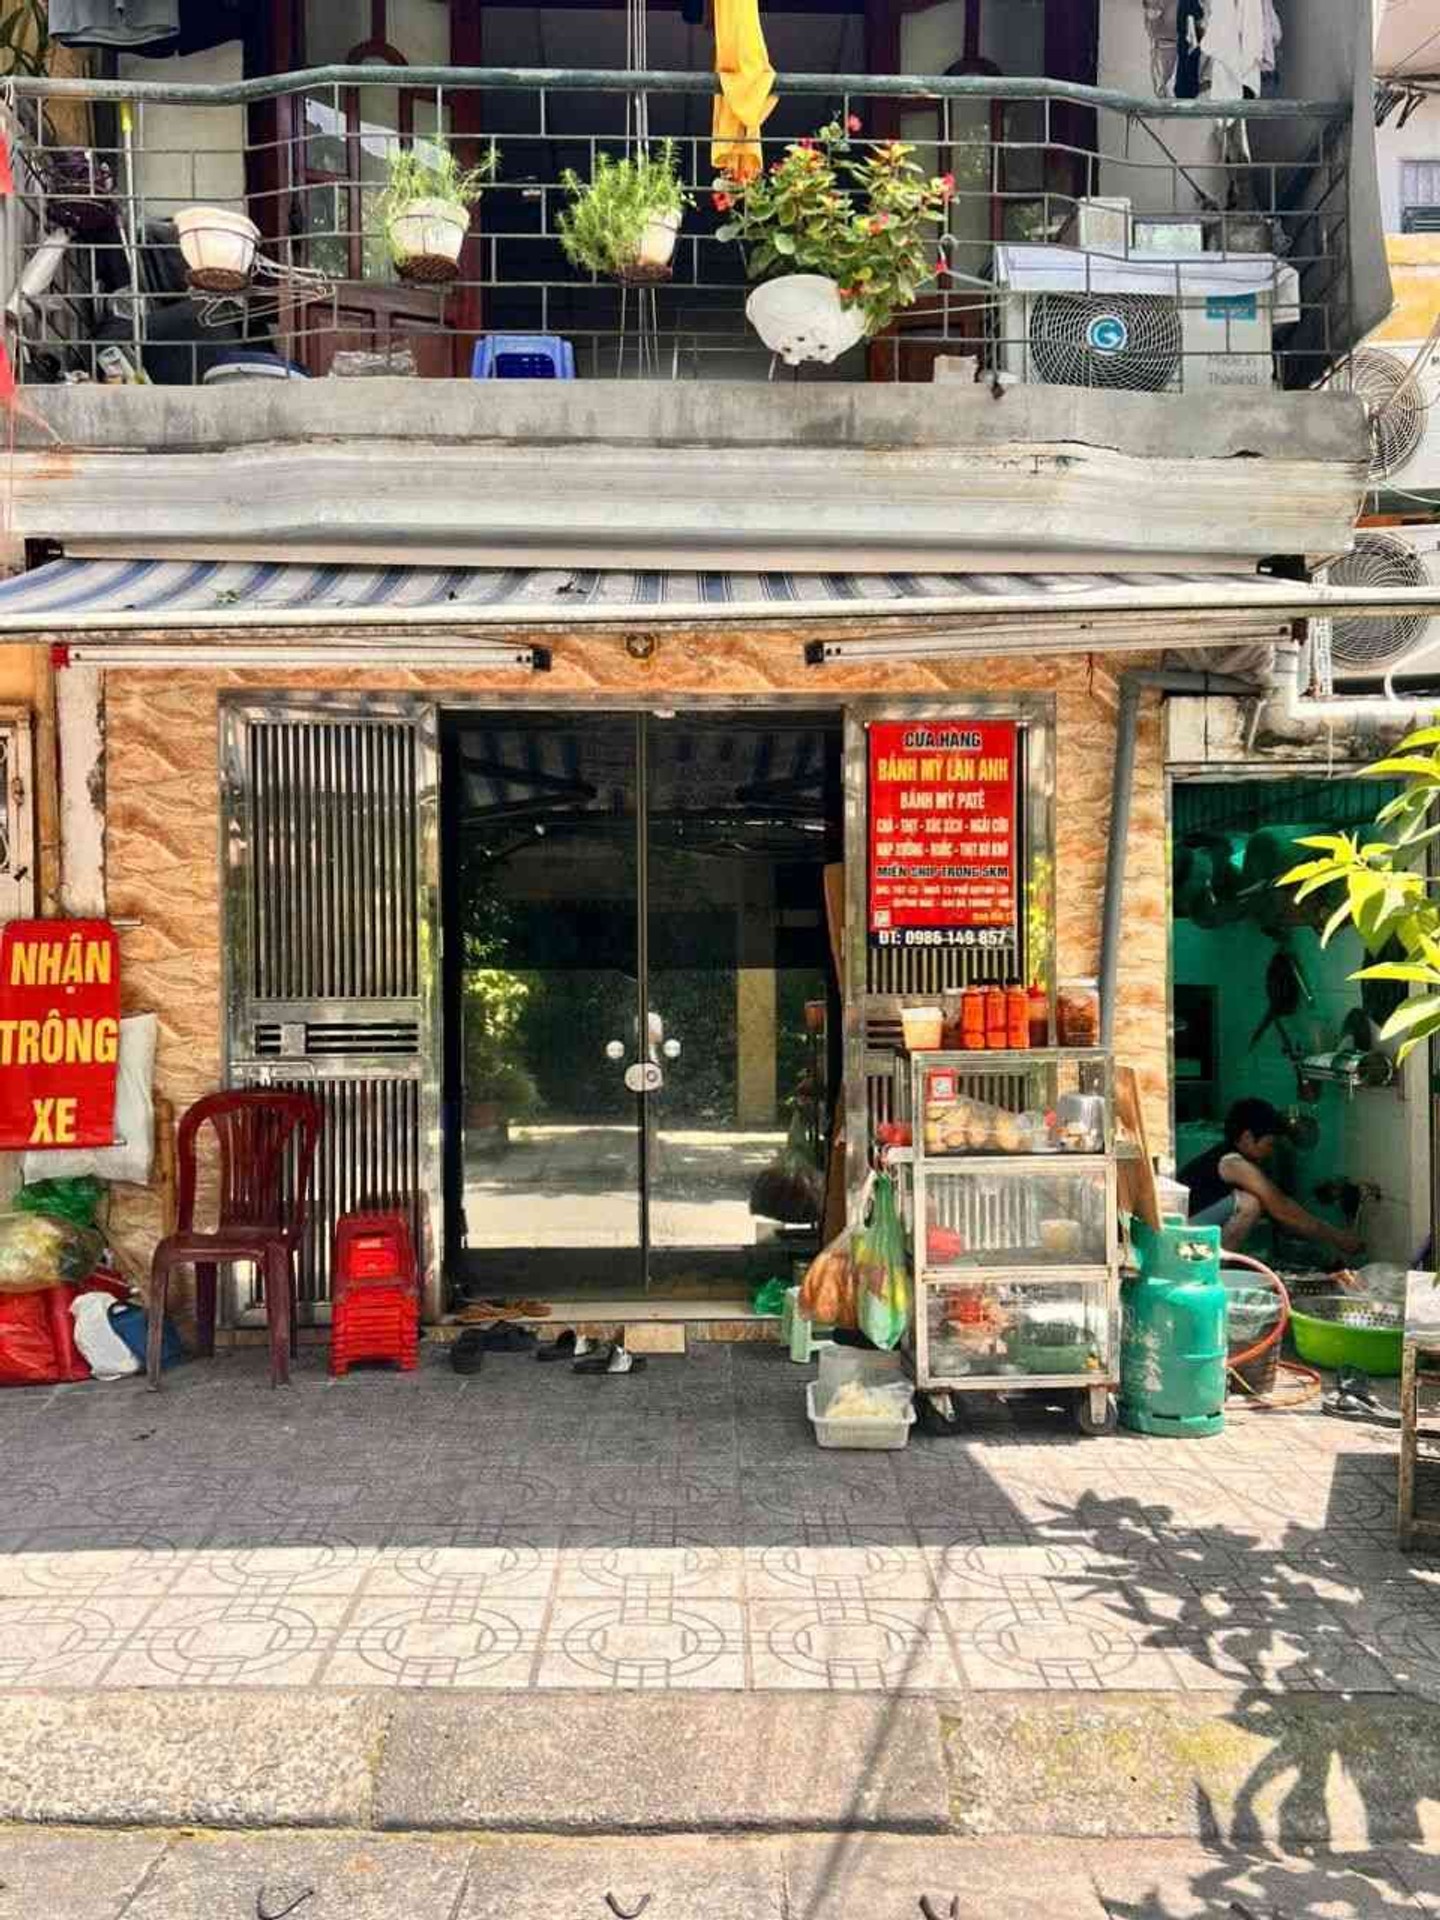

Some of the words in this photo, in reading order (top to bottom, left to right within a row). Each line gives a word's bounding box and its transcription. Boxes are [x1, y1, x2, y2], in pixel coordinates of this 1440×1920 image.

[878, 750, 917, 781] BÁNH
[978, 758, 1009, 781] ANH
[900, 788, 934, 809] BÁNH
[10, 932, 112, 994] NHẬN
[0, 1008, 119, 1065] TRÔNG
[28, 1097, 78, 1145] XE
